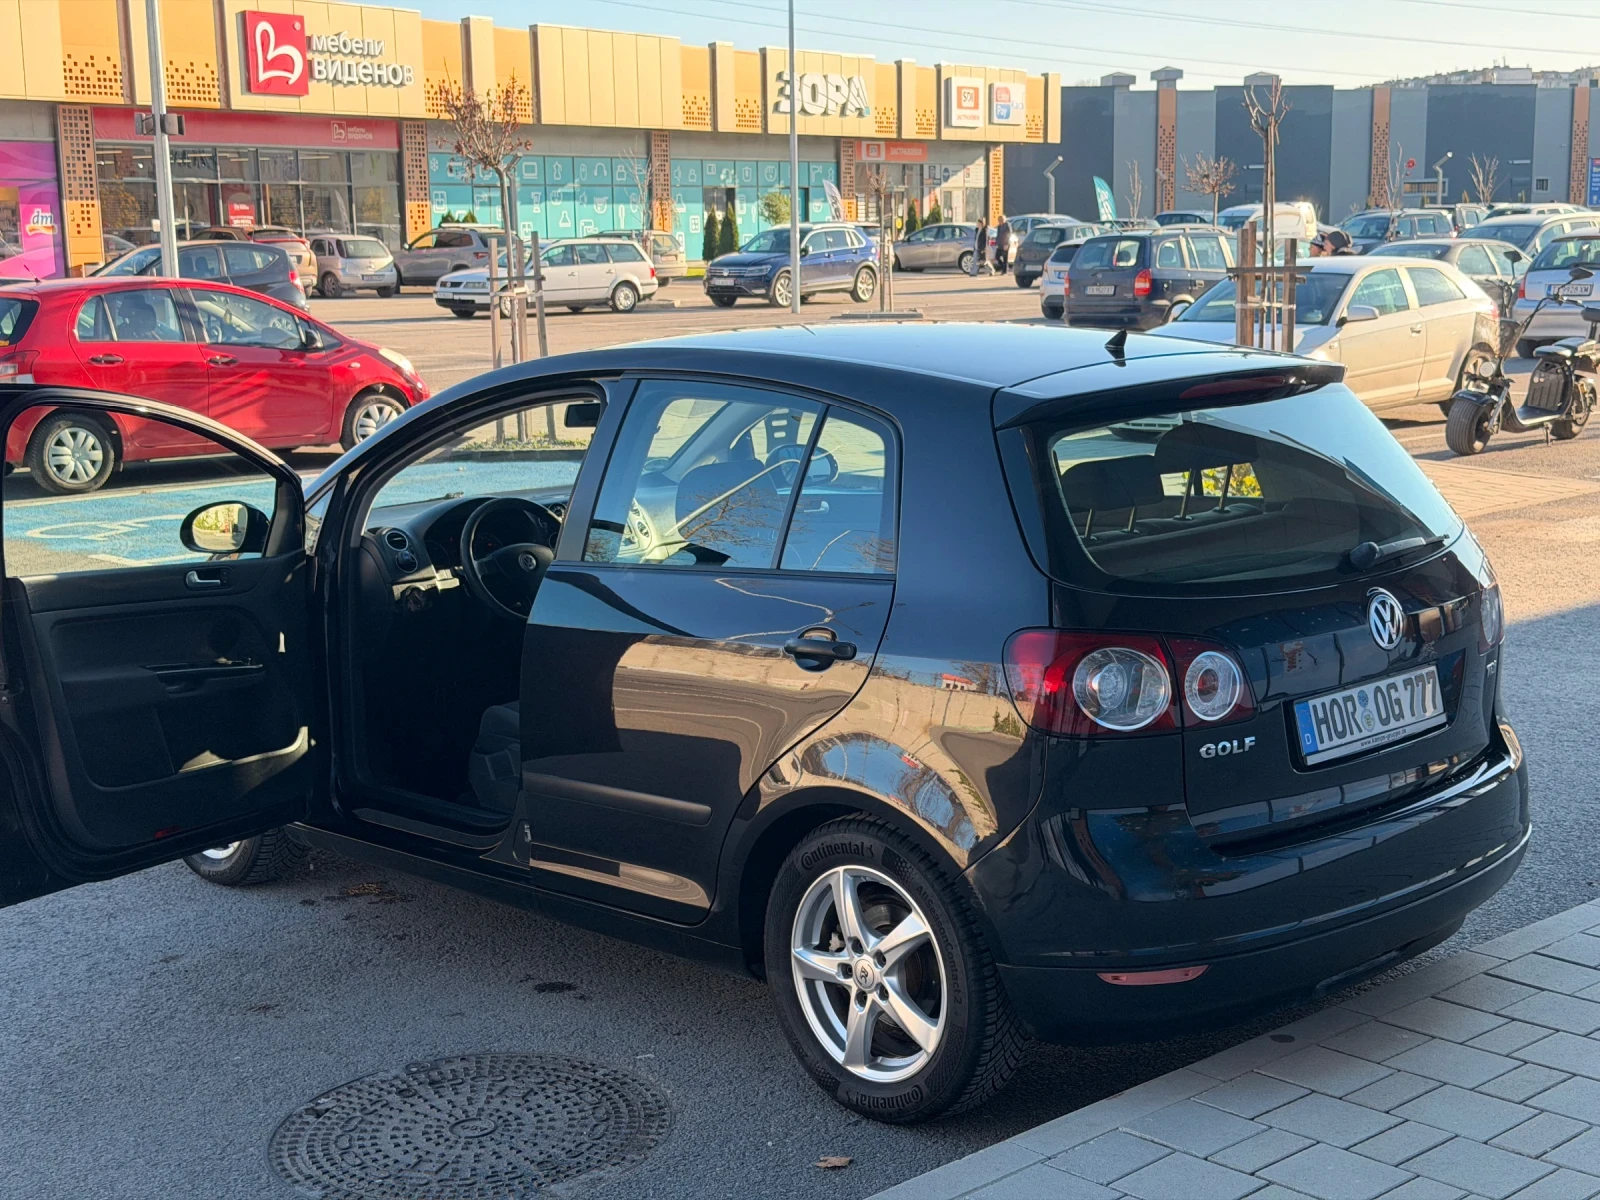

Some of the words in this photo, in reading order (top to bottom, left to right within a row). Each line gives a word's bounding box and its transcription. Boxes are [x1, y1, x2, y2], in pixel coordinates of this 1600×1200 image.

[311, 30, 385, 56] мебели
[312, 57, 415, 86] виденов
[32, 210, 53, 226] dm
[1312, 694, 1363, 745] HOR
[1373, 682, 1405, 726] OG
[1403, 670, 1437, 718] 777
[1199, 736, 1256, 759] GOLF
[1304, 733, 1312, 745] D
[801, 841, 865, 871] Continental
